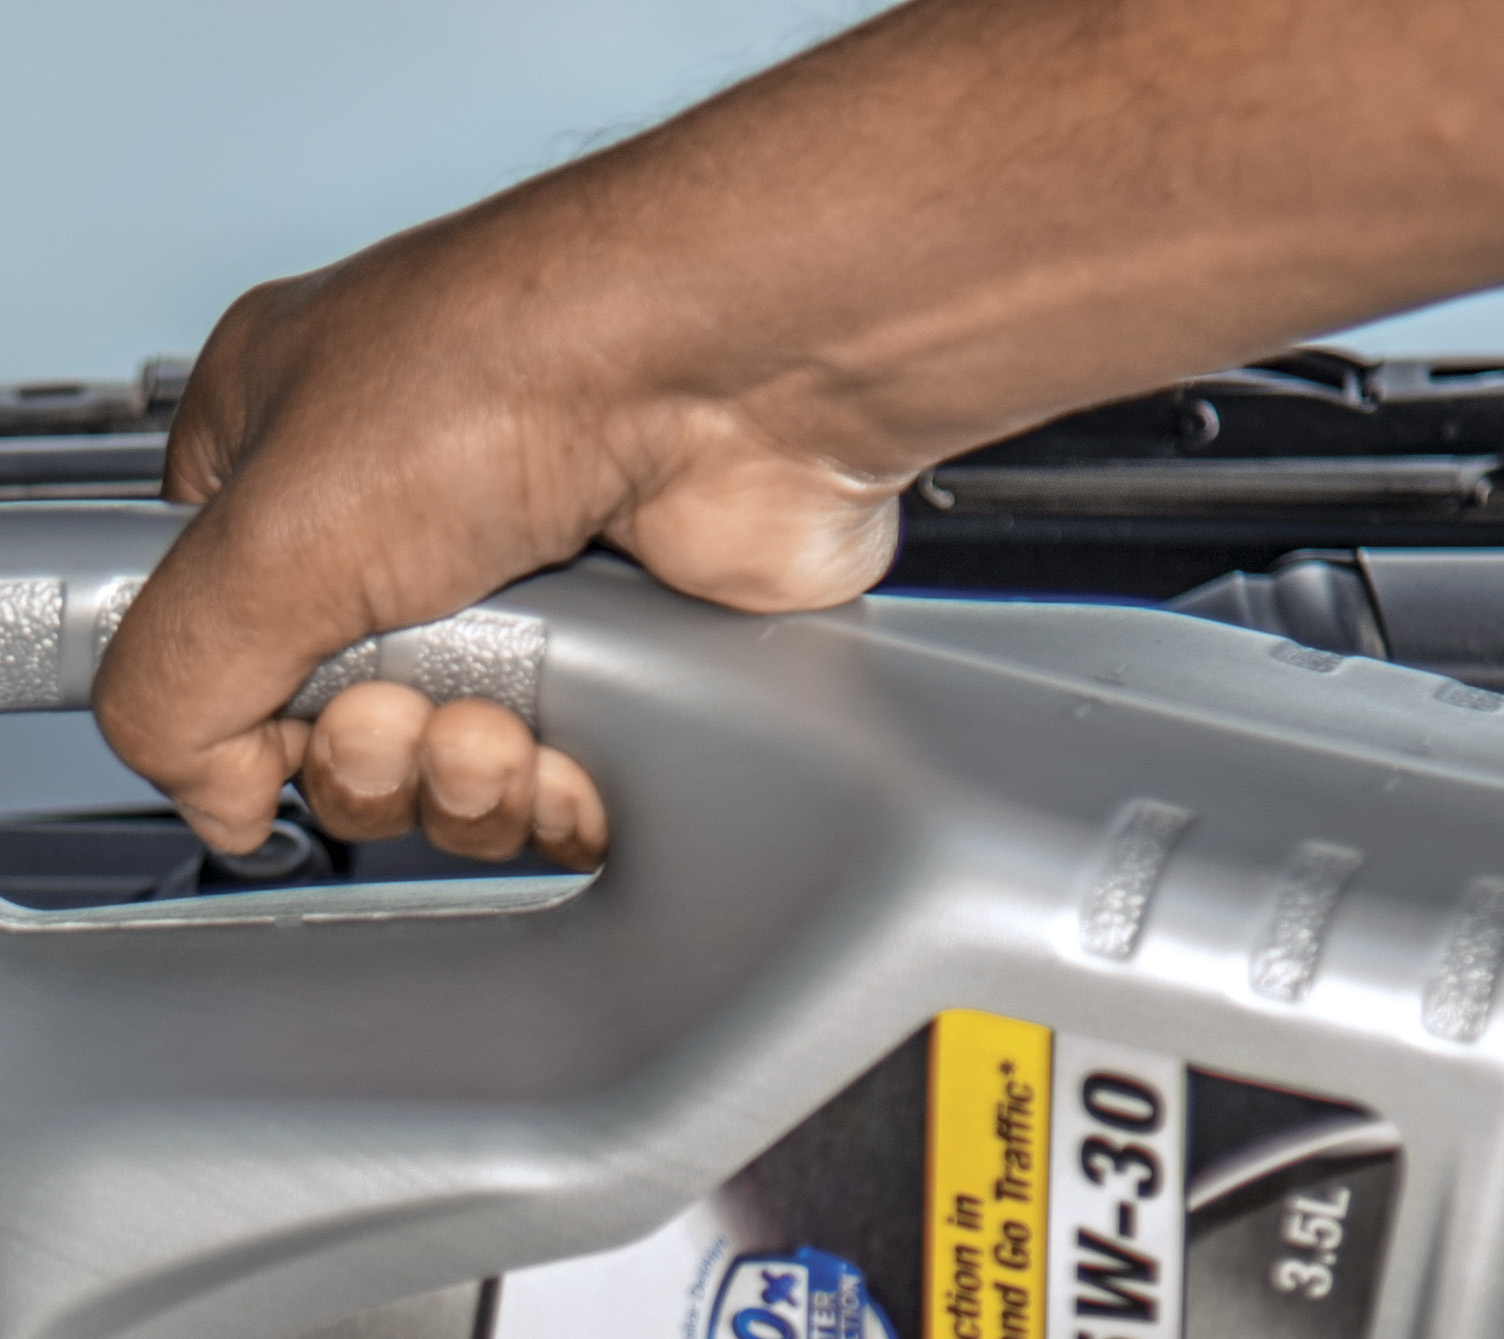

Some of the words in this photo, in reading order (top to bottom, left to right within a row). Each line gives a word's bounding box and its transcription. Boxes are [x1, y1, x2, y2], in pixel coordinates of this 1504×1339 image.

[948, 1194, 984, 1232] in
[993, 1221, 1033, 1271] Go
[1274, 1187, 1351, 1297] 3.5L
